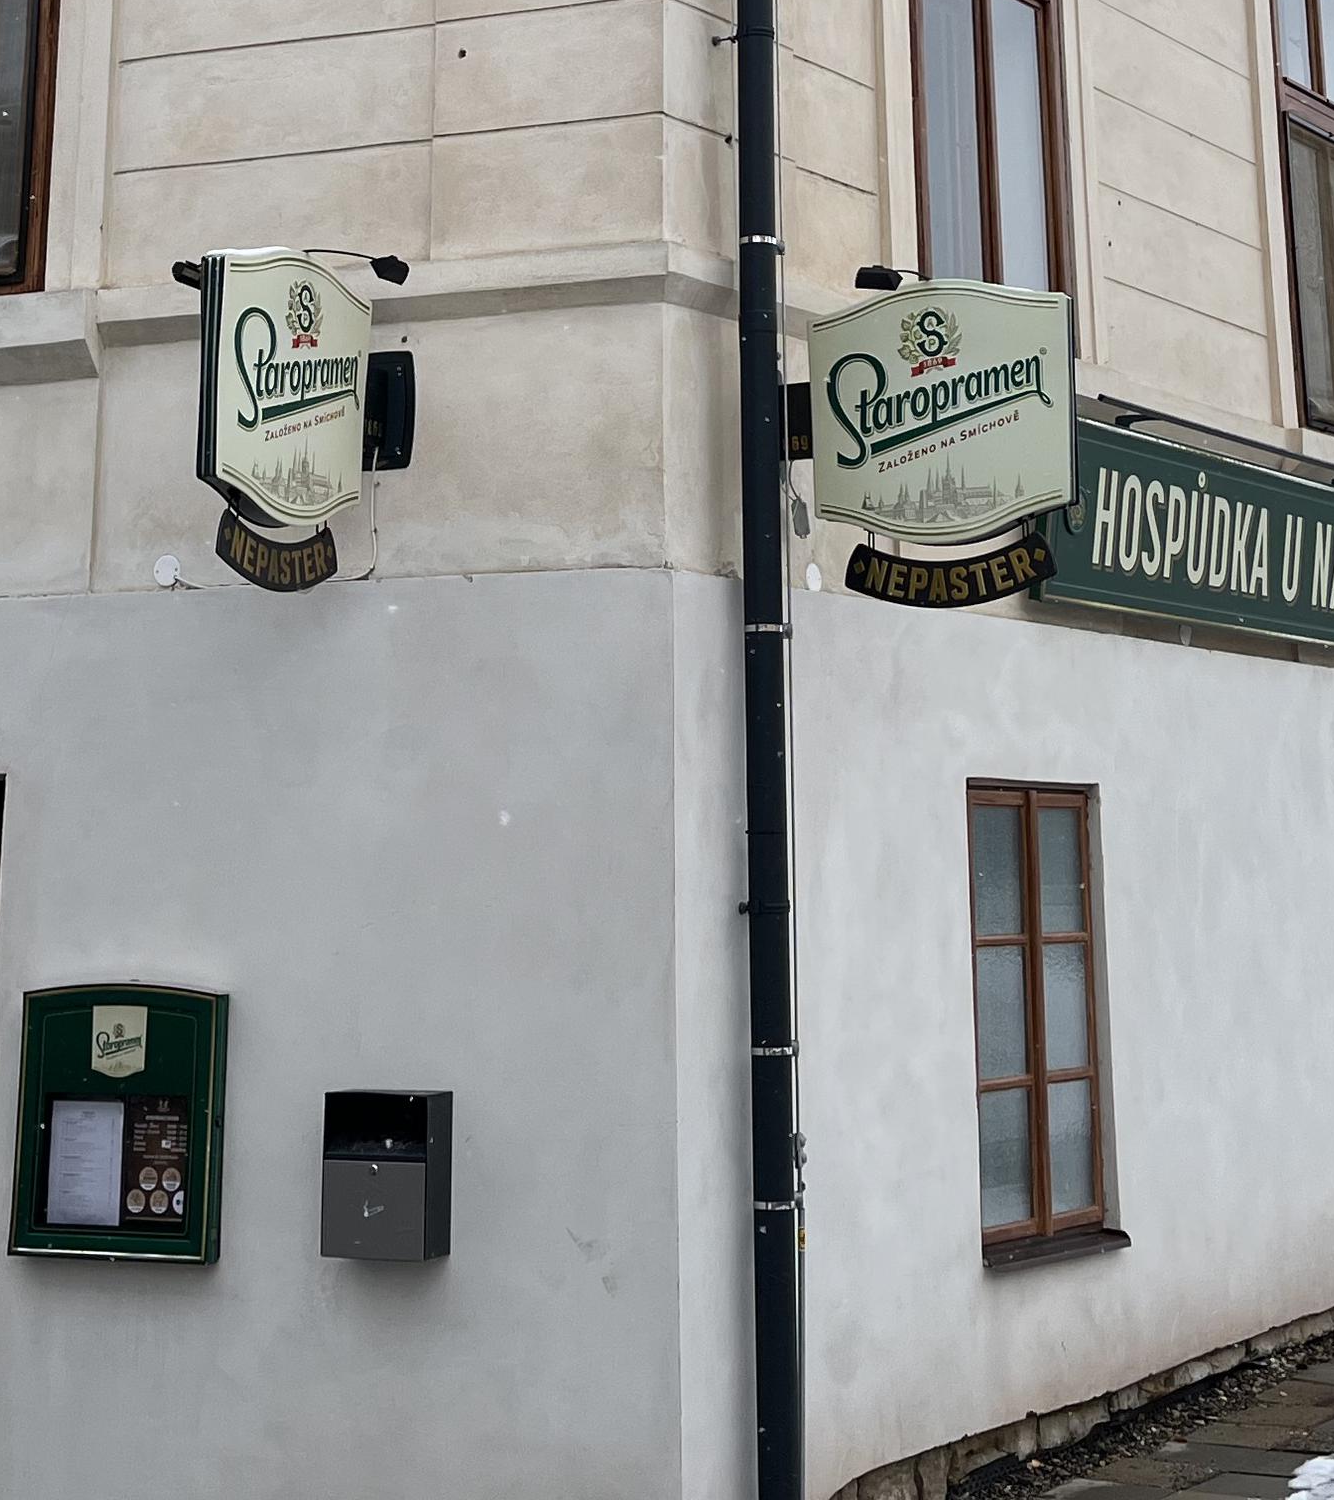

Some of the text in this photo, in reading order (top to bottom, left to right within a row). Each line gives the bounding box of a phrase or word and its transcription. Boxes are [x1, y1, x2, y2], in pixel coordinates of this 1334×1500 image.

[234, 307, 360, 430] Staropramen
[923, 358, 943, 369] 1869
[827, 353, 1054, 468] Staropramen
[940, 437, 957, 450] NA
[230, 524, 328, 585] NEPASTER
[1091, 467, 1269, 597] HOSPŮDKA
[1282, 514, 1304, 602] U
[867, 547, 1037, 602] NEPASTER
